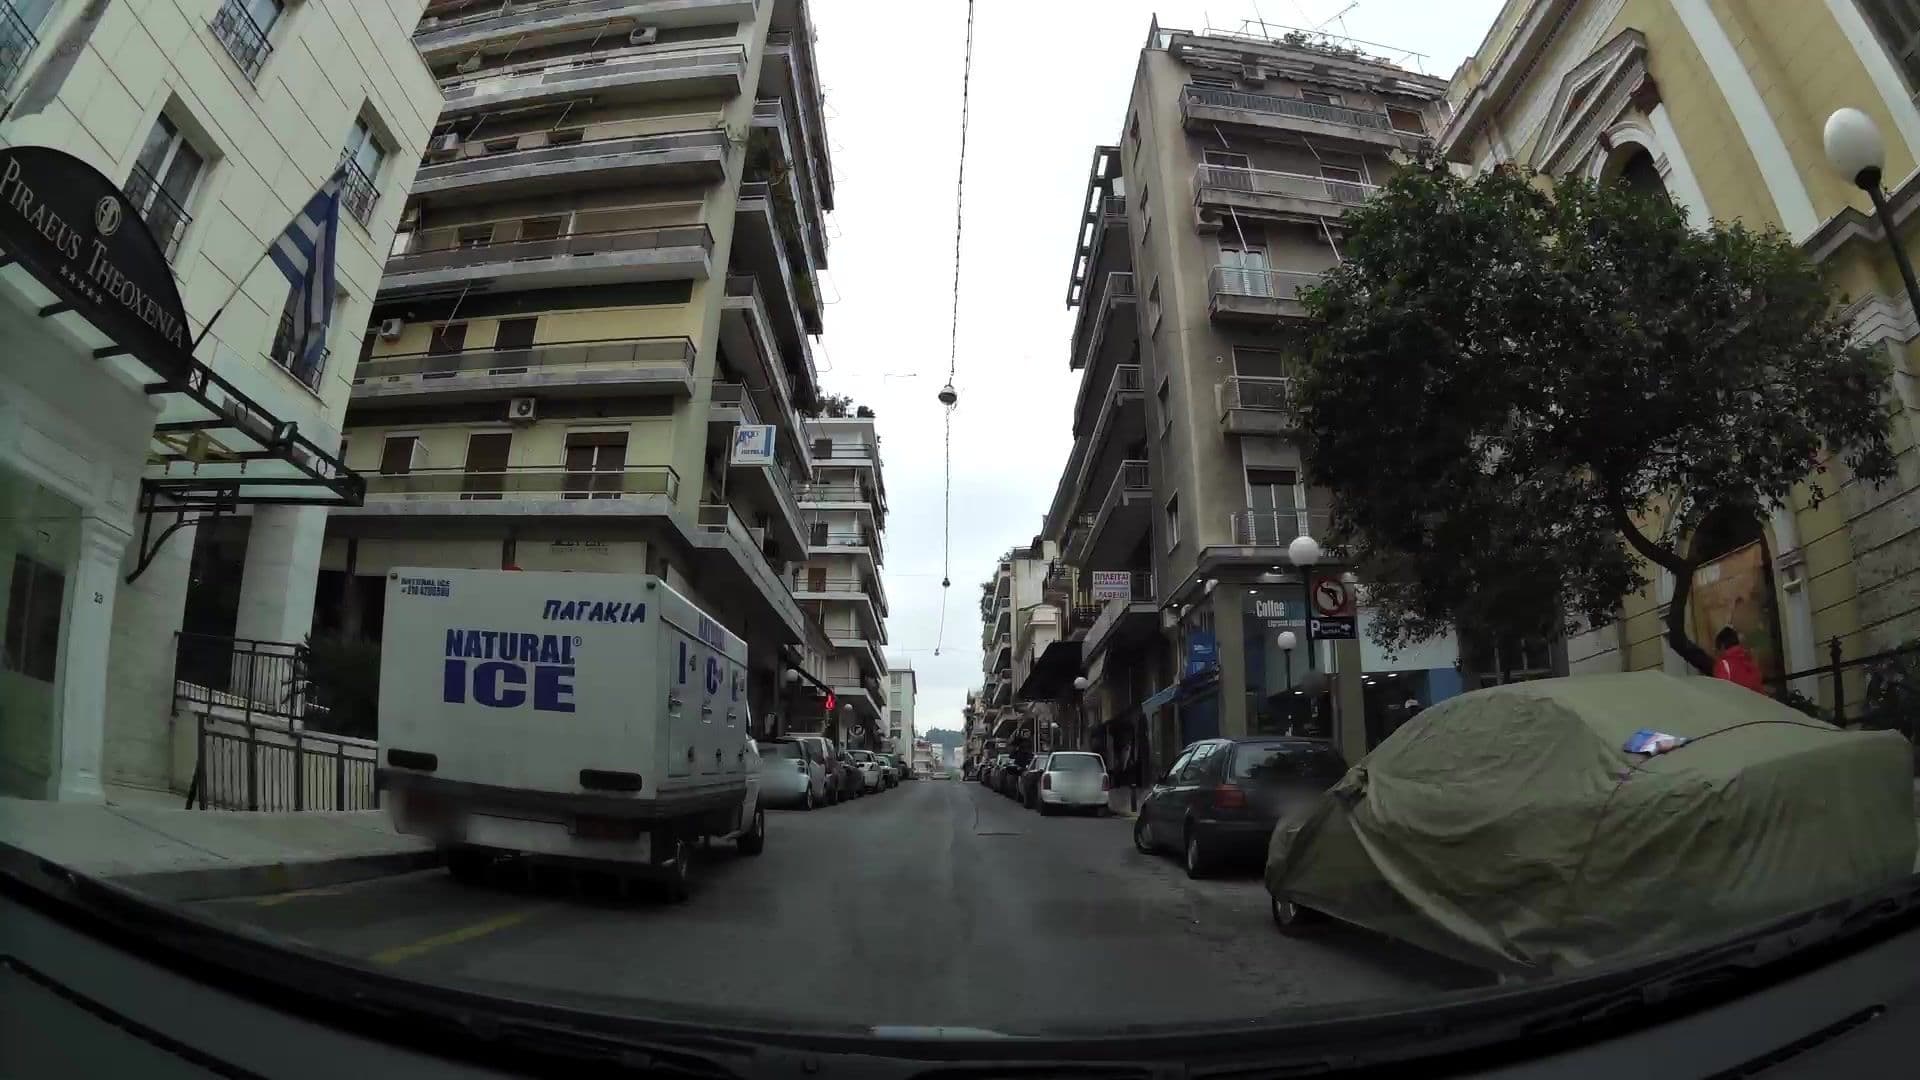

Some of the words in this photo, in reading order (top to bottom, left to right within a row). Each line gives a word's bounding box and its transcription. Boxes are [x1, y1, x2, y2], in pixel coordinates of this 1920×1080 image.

[0, 157, 82, 260] PIRAEUS
[87, 239, 186, 348] THEOXENIA
[542, 599, 646, 624] ΠΑΓΑΚΙΑ
[443, 659, 576, 713] ICE
